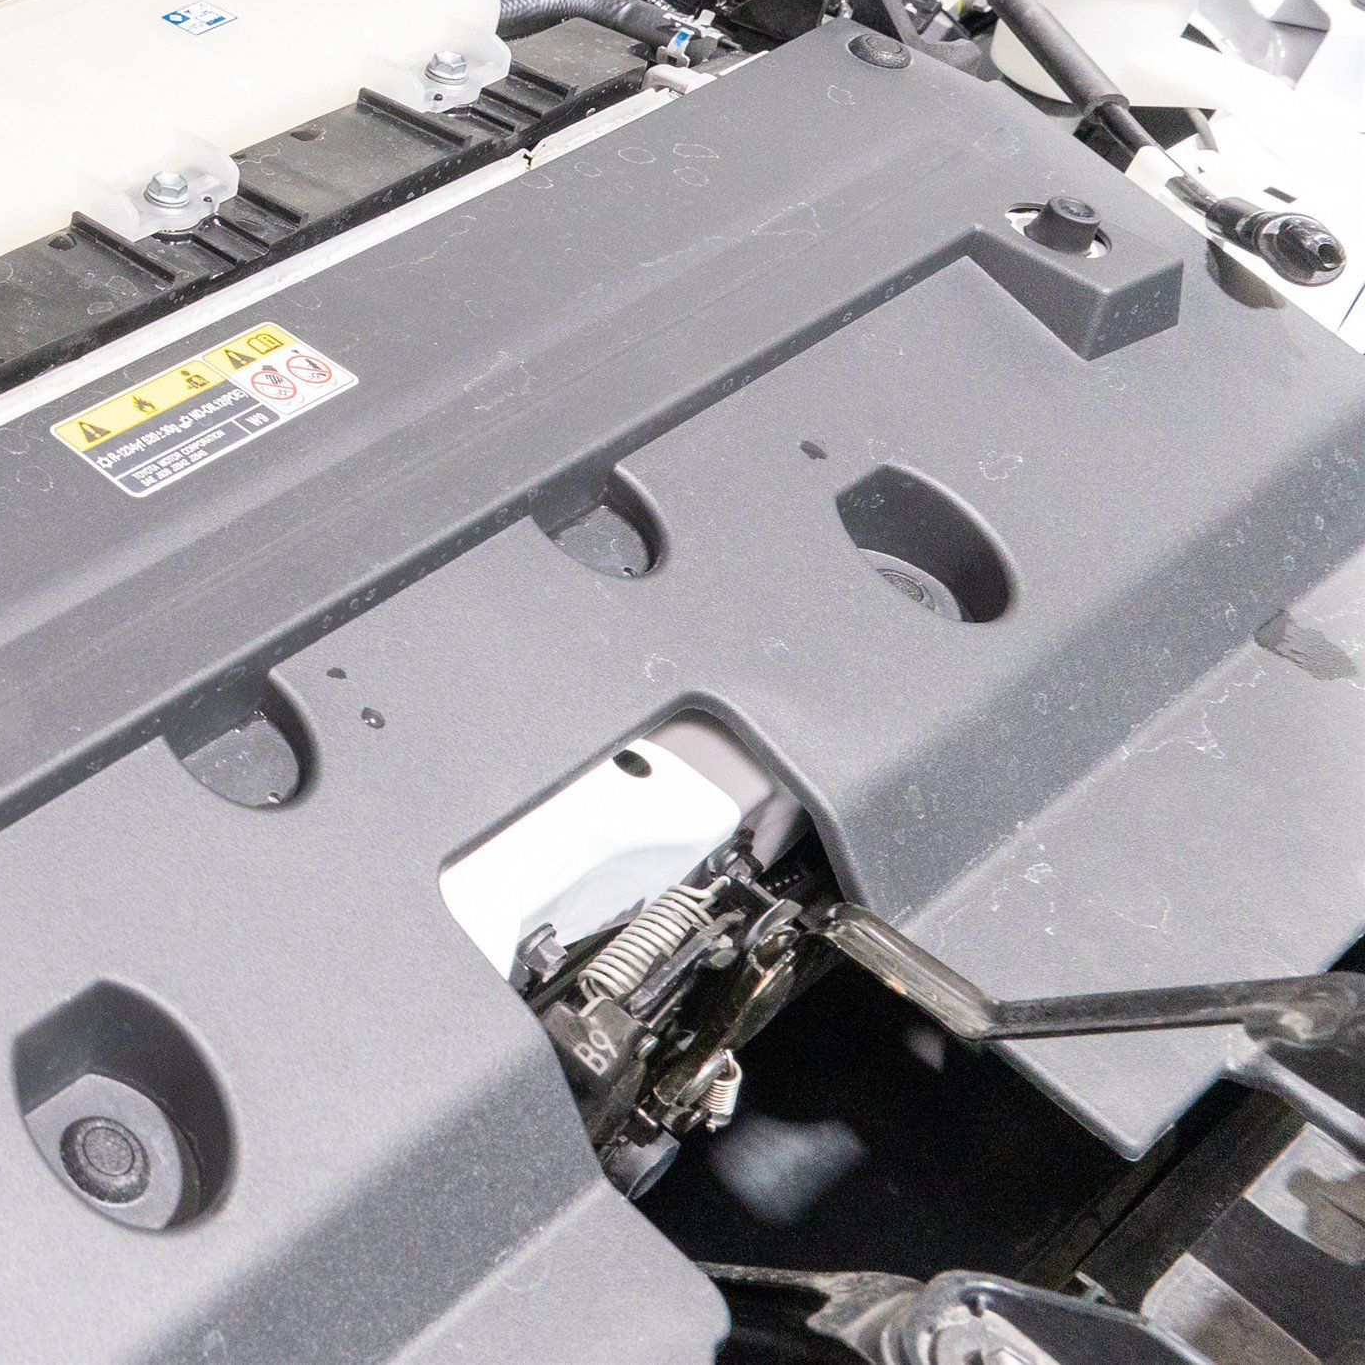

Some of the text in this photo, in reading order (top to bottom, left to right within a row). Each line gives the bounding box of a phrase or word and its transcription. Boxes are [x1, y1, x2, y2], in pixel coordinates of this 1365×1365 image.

[243, 411, 272, 427] W9
[130, 428, 227, 482] TOYOTA MOTOR CORPORATION
[572, 1028, 622, 1078] B9
